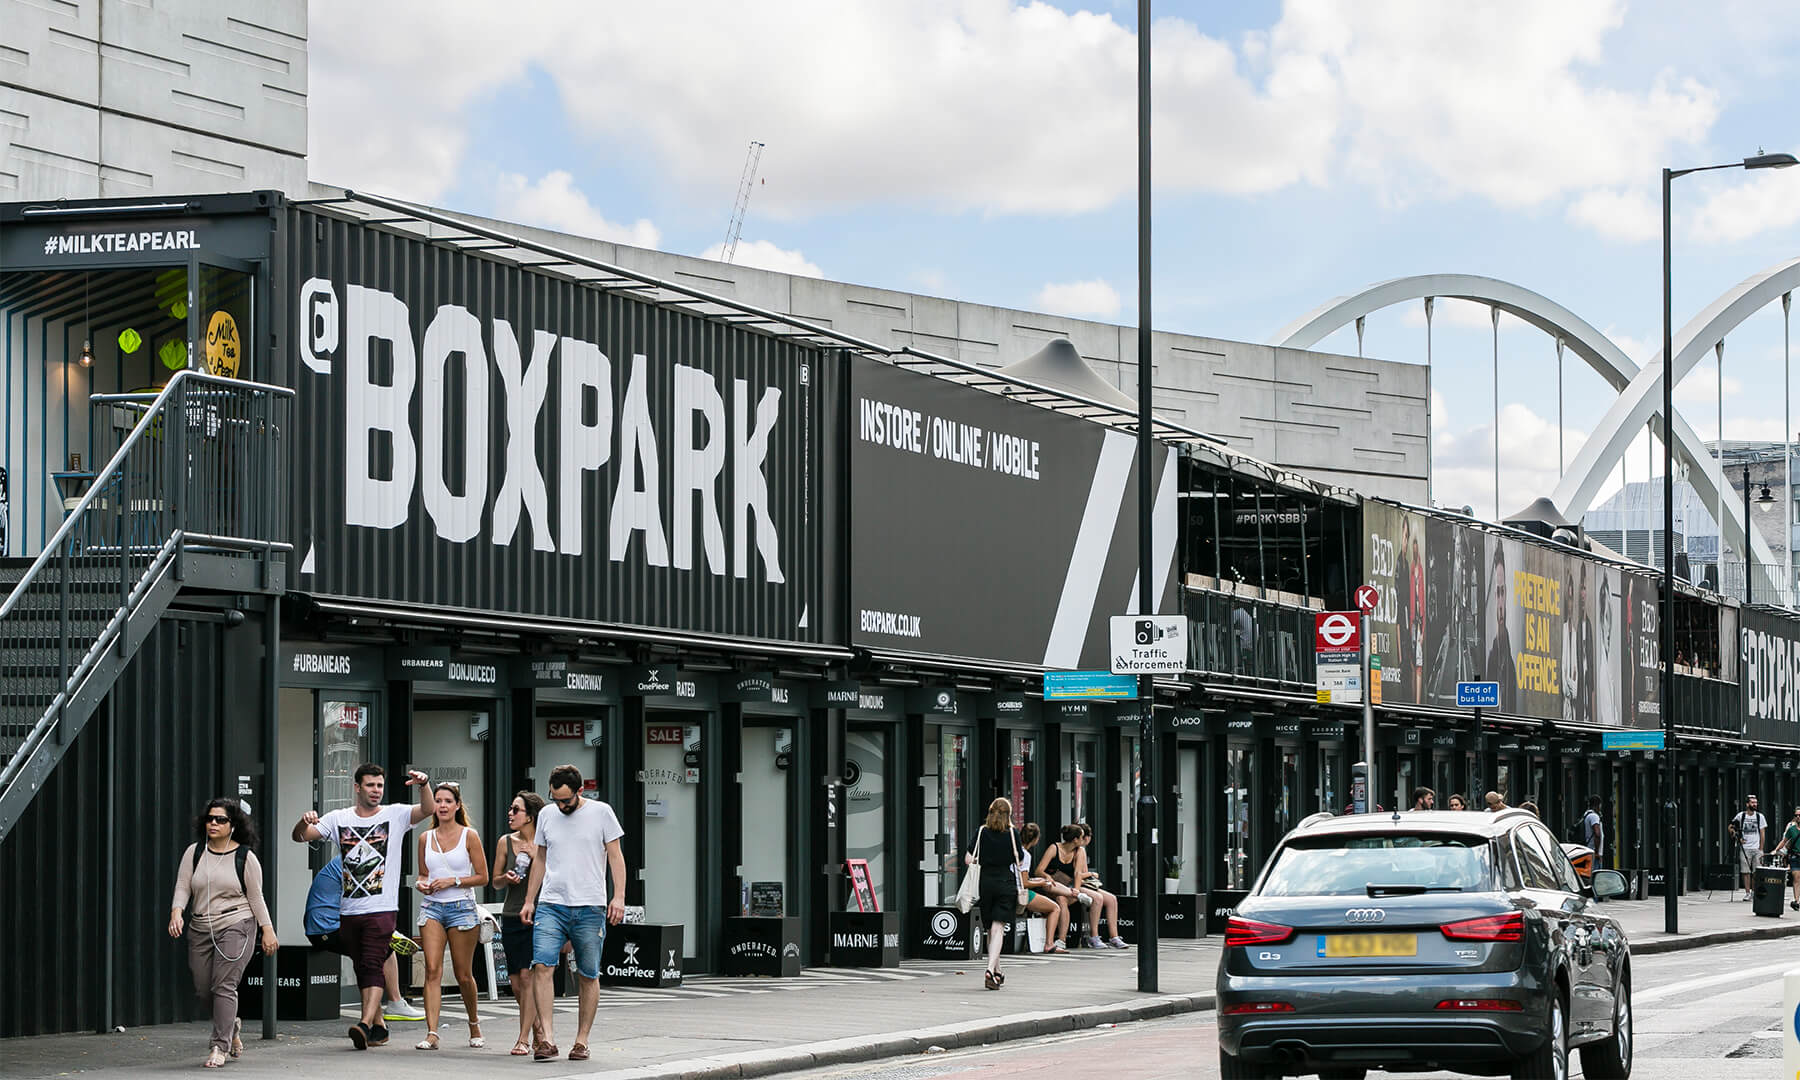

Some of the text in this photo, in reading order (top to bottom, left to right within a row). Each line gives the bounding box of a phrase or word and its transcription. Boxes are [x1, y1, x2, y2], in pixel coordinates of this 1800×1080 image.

[44, 230, 201, 255] #MILKTEAPEARL
[209, 318, 235, 346] Milk
[222, 343, 236, 358] Tea
[300, 274, 785, 584] @BOXPARK
[860, 398, 1040, 480] INSTORE / ONLINE / MOBILE
[1371, 533, 1394, 577] BED
[1358, 590, 1373, 608] K
[1514, 569, 1560, 616] PRETENCE
[860, 609, 921, 639] BOXPARK.CO.UK
[1526, 613, 1549, 654] IS AN
[1132, 648, 1168, 658] Traffic
[293, 653, 351, 675] #URBANEARS
[401, 659, 444, 668] URBANEARS
[1516, 651, 1560, 695] OFFENCE
[638, 683, 670, 691] OnePiece
[1464, 686, 1492, 694] End of
[1460, 695, 1496, 703] bus lane
[1061, 705, 1088, 713] HYMN
[1180, 717, 1200, 726] MOO
[1228, 721, 1253, 729] #POPUP
[549, 723, 582, 737] SALE
[649, 729, 681, 742] SALE
[1259, 951, 1281, 961] Q3
[606, 965, 656, 978] OnePiece
